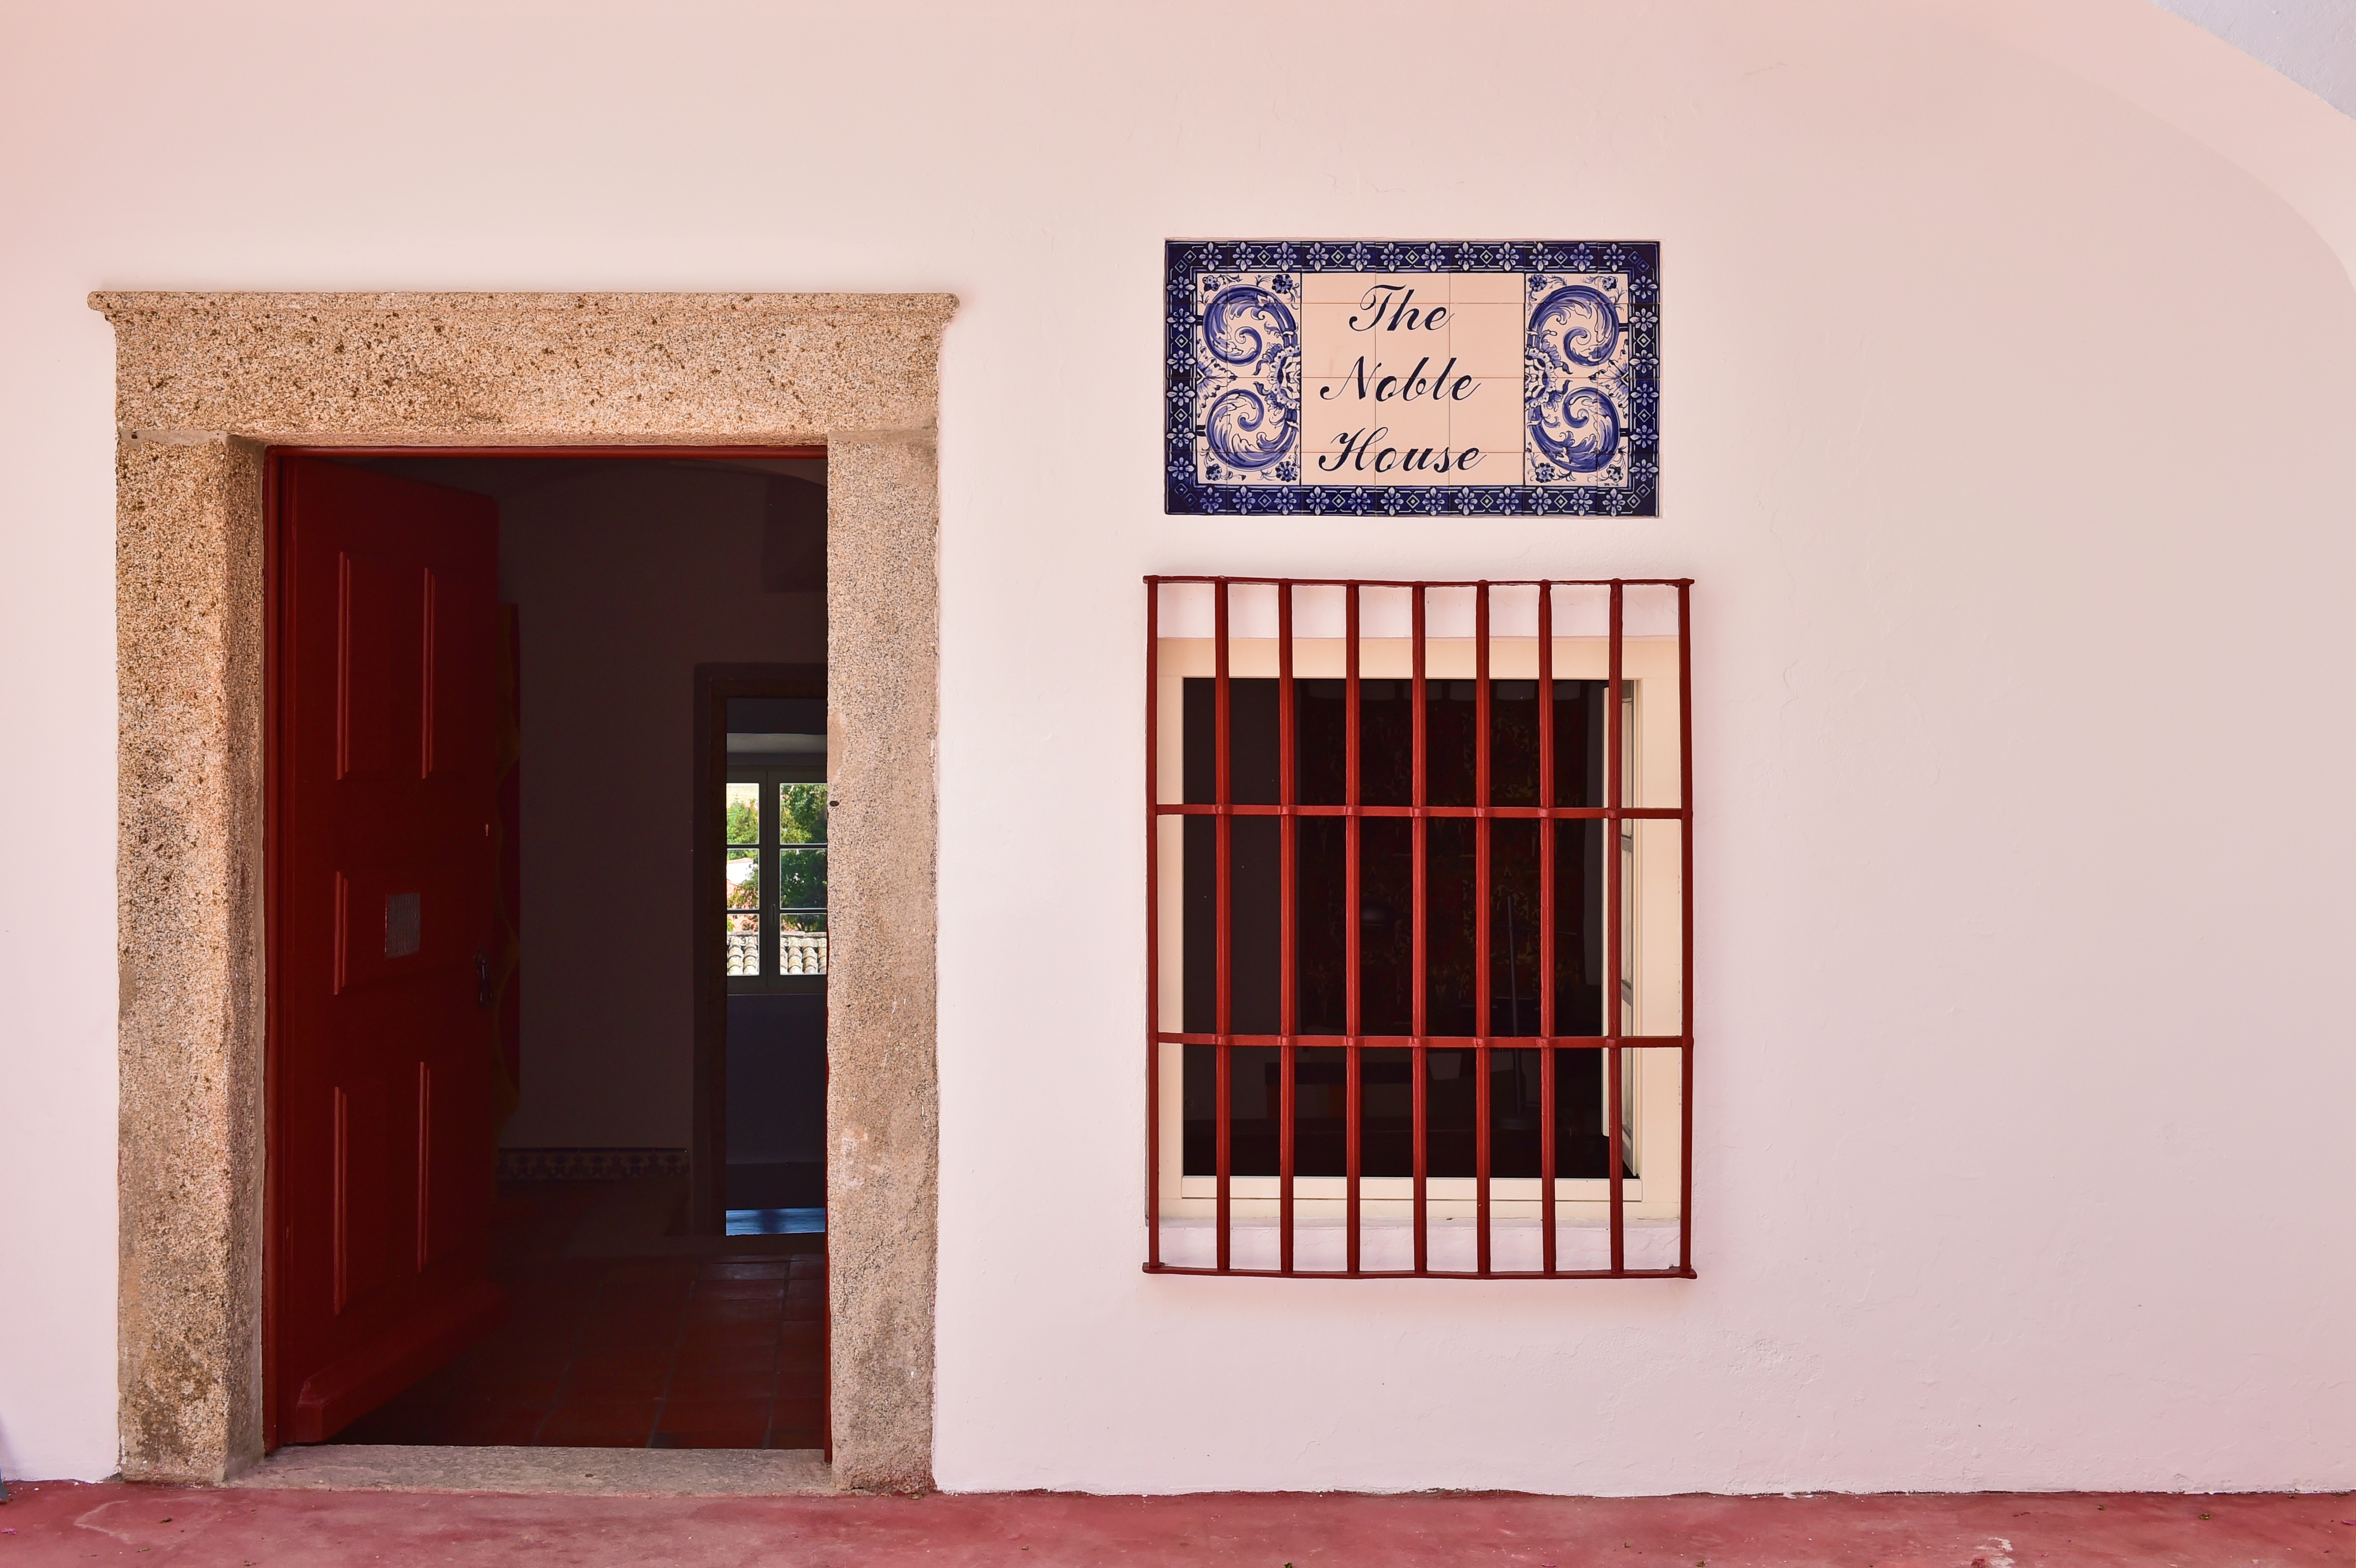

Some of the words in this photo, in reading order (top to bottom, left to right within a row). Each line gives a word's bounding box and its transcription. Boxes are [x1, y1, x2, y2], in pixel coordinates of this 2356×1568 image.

[1349, 284, 1455, 331] The
[1320, 356, 1481, 402] Noble
[1318, 426, 1487, 473] House
